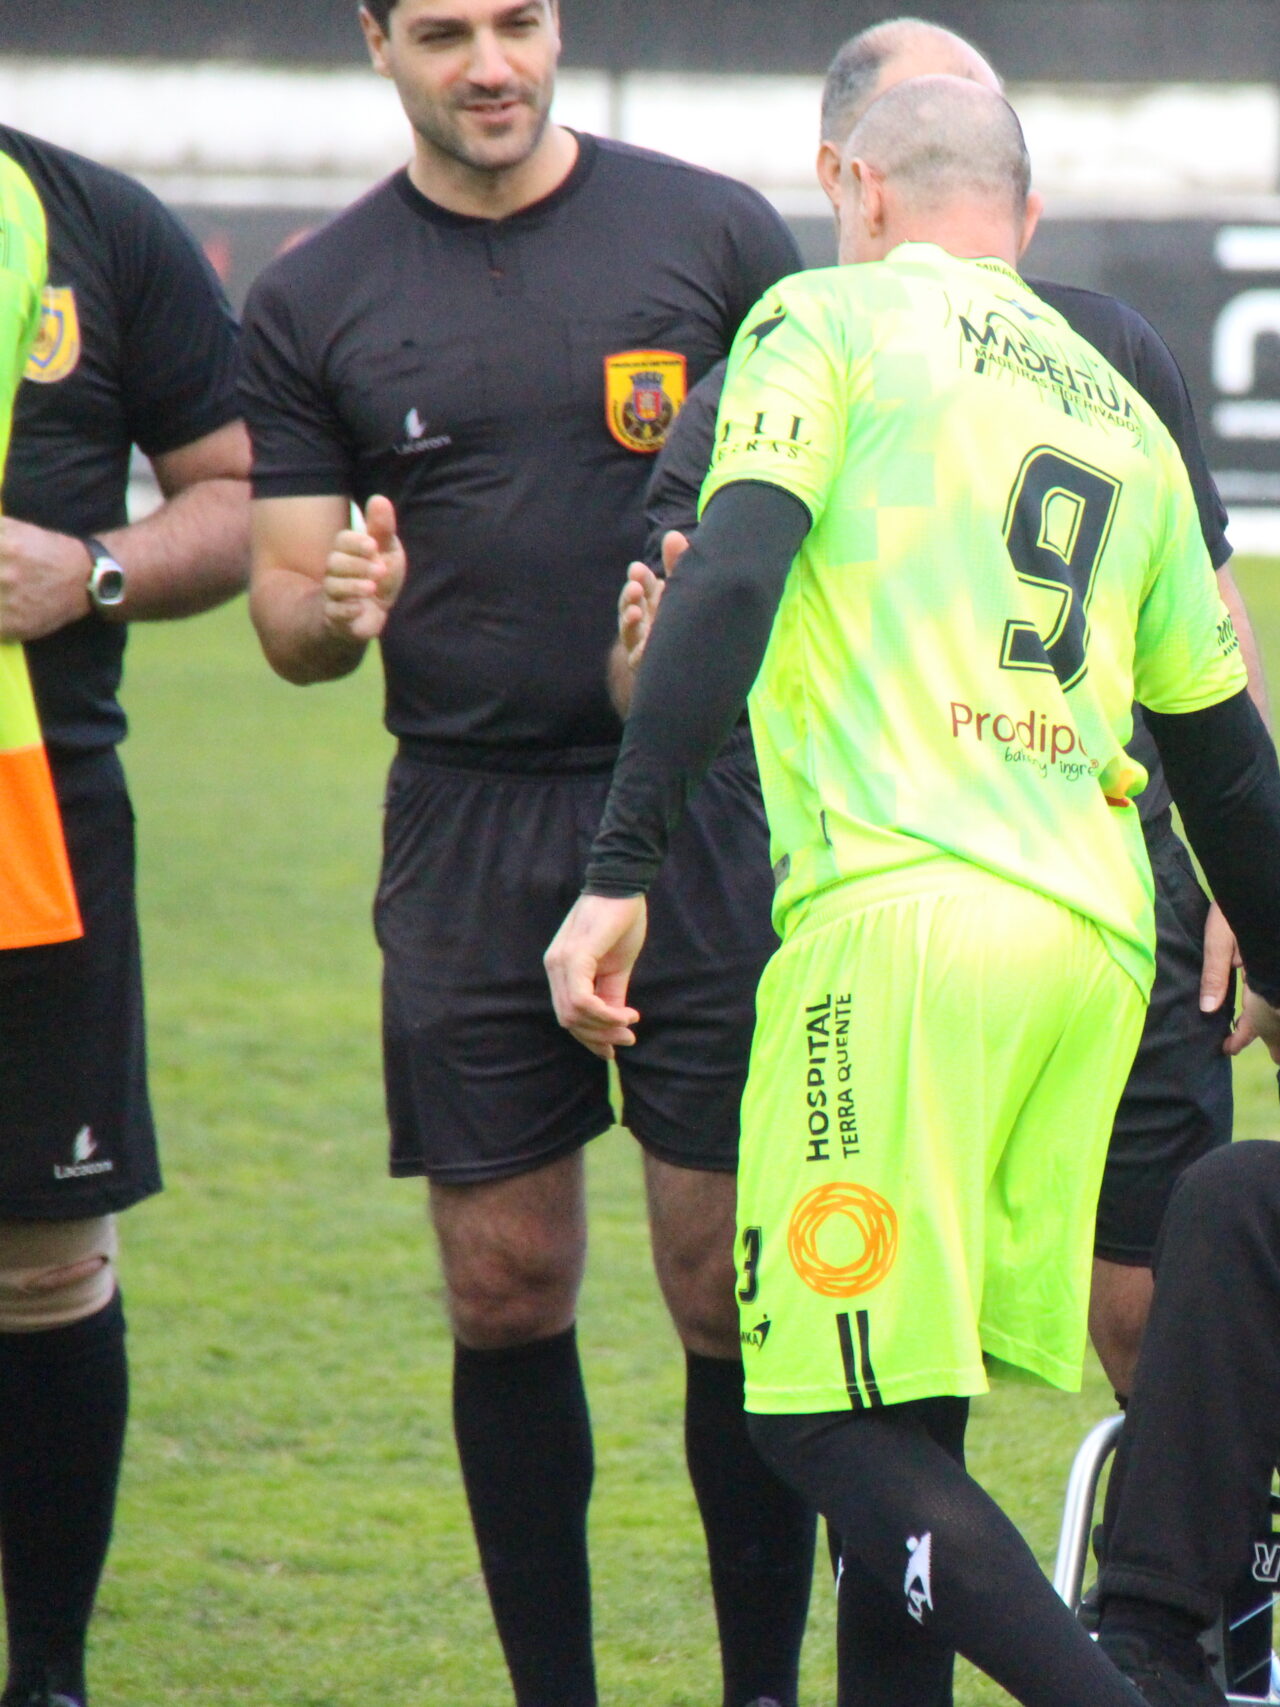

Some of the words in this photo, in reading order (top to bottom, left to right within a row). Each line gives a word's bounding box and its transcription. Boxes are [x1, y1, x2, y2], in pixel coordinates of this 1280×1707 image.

[1000, 443, 1123, 693] 9
[806, 994, 831, 1162] HOSPITAL
[835, 993, 852, 1082] QUENTE
[837, 1088, 860, 1159] TERRA
